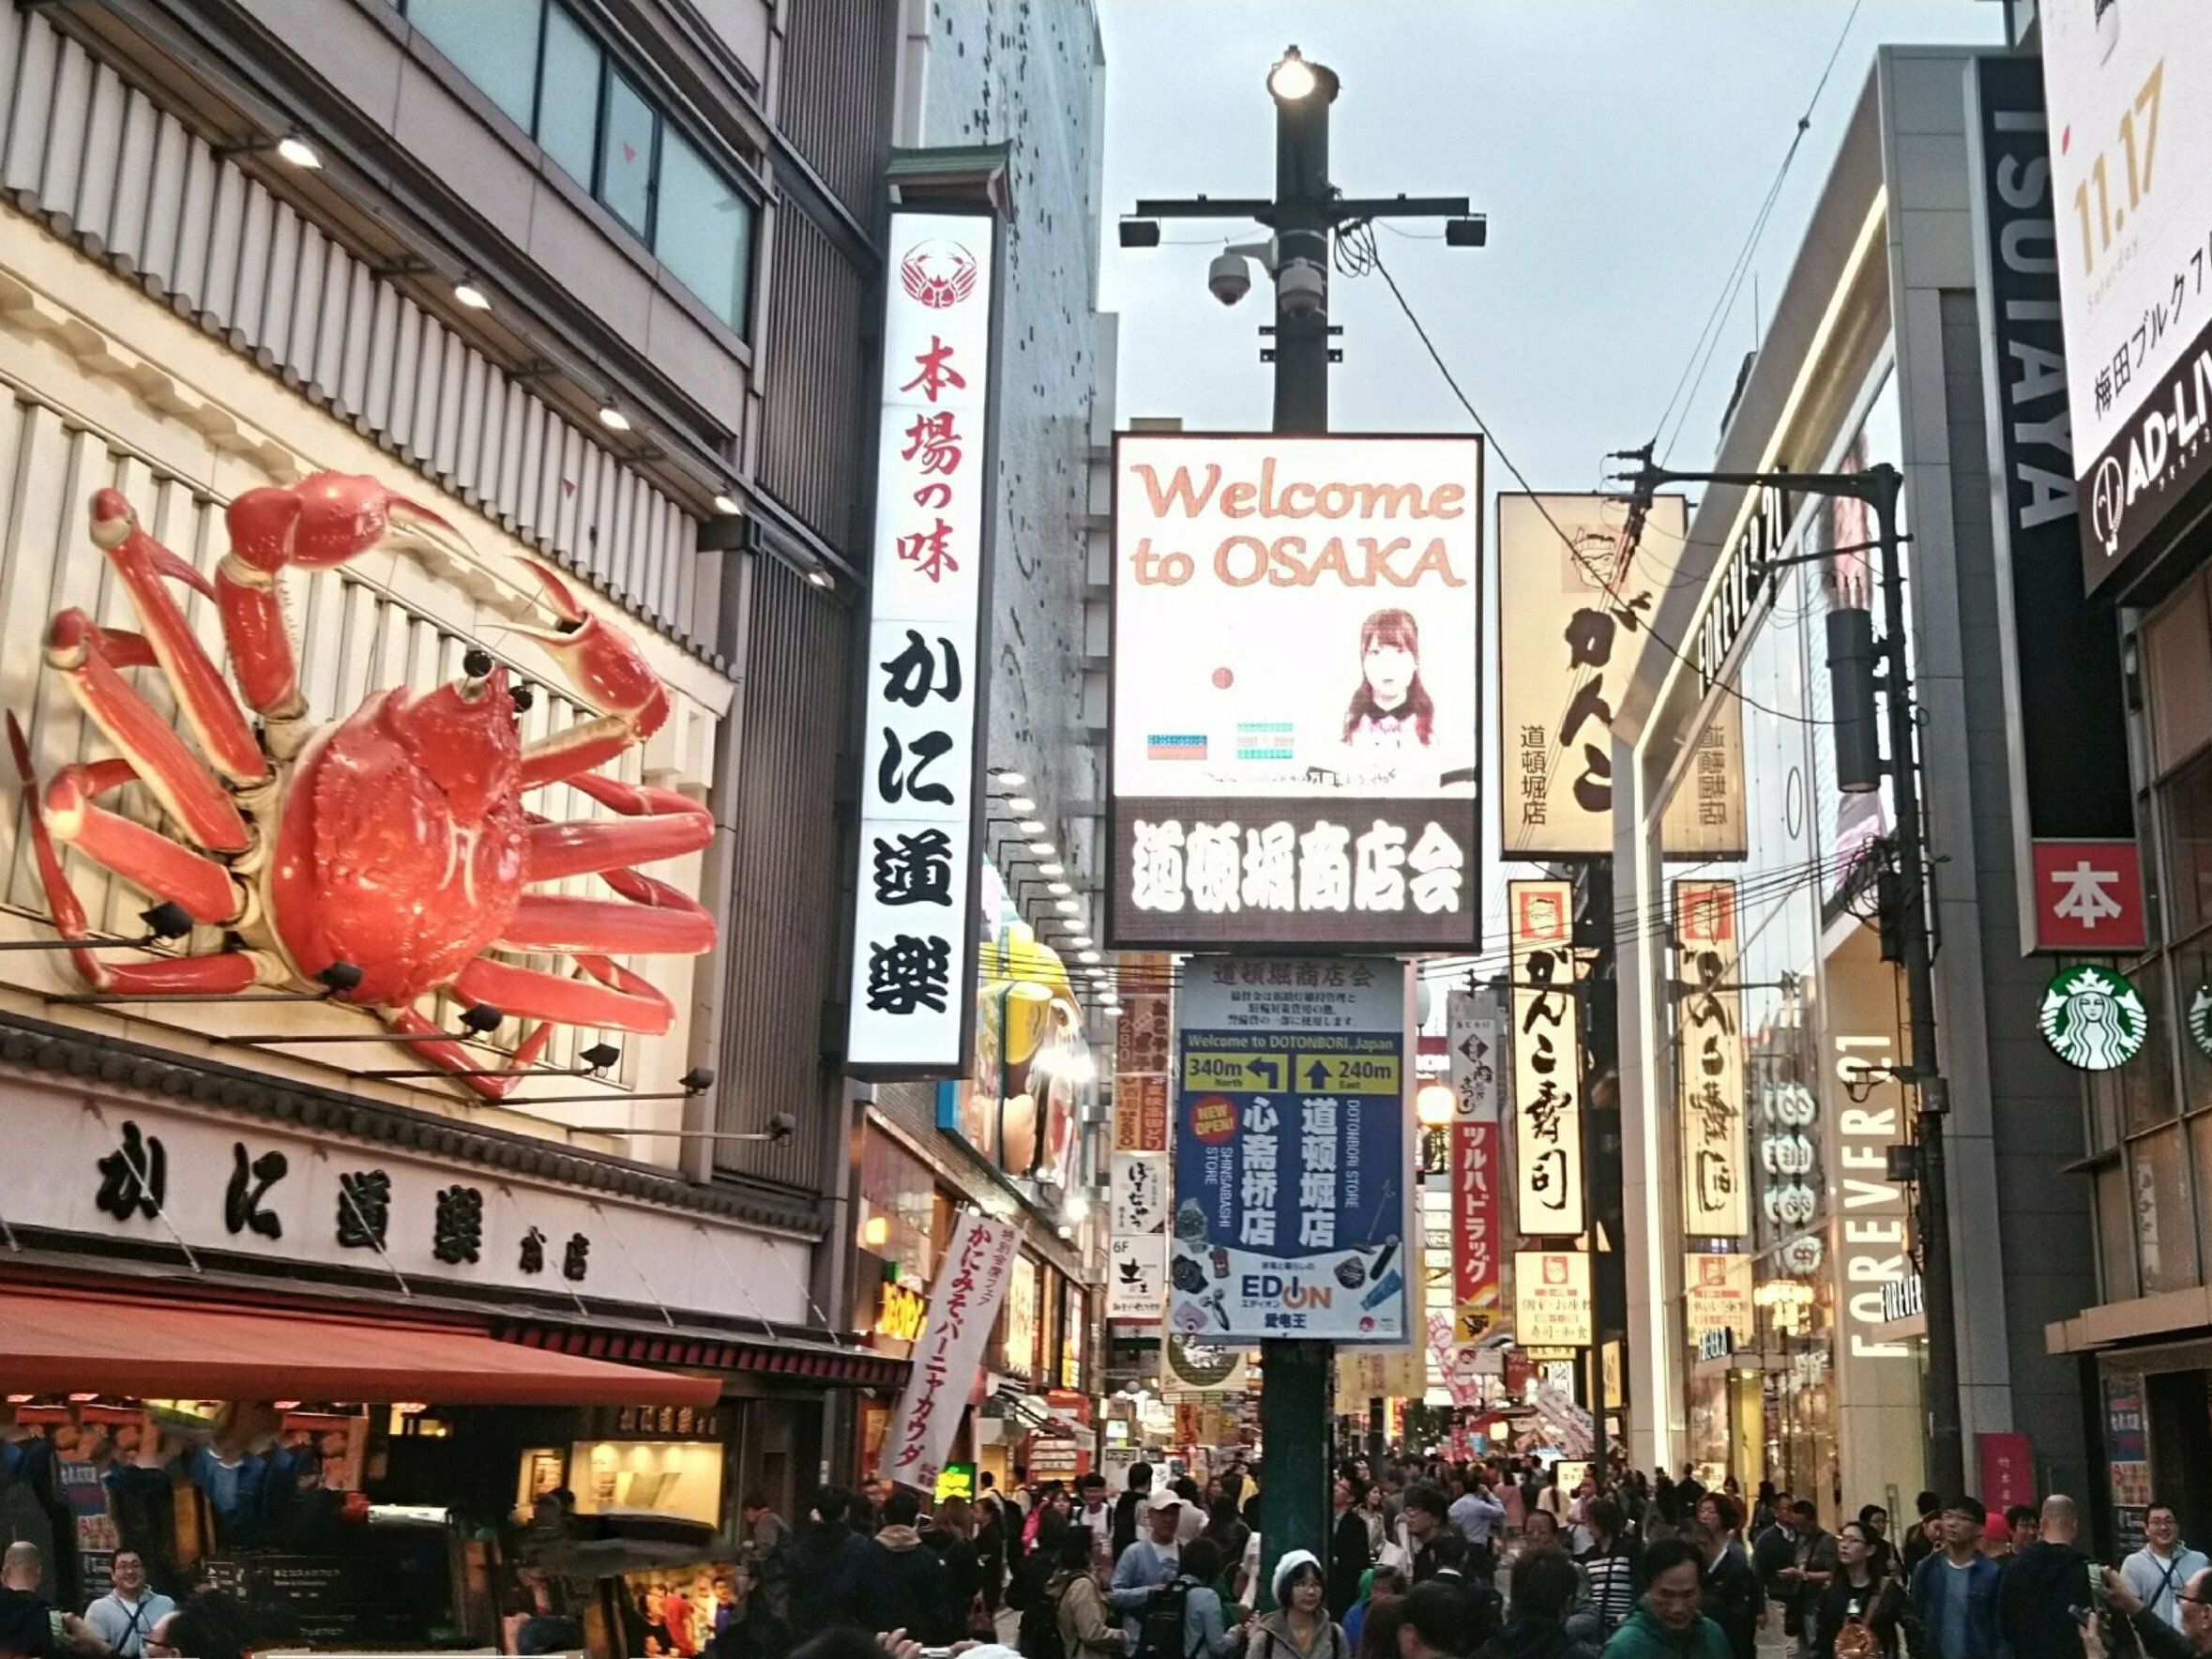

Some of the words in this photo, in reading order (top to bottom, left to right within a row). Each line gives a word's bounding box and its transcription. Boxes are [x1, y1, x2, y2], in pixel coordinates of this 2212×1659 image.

[2074, 58, 2164, 278] 11.17
[896, 334, 967, 584] 本場の味
[1129, 457, 1466, 520] Welcome
[1129, 537, 1195, 586] to
[1213, 535, 1467, 587] OSAKA
[1520, 725, 1548, 826] 道頓堀店
[865, 629, 962, 1015] かに道楽
[1131, 818, 1464, 915] 道頓堀商店会
[2051, 860, 2123, 928] 本
[1213, 960, 1376, 988] 道頓堀商店会
[1188, 1034, 1248, 1047] Welcome
[1252, 1035, 1265, 1047] to
[1355, 1038, 1394, 1051] Japan
[1189, 1058, 1242, 1077] 340m
[1215, 1078, 1243, 1088] North
[1339, 1060, 1392, 1079] 240m
[1340, 1080, 1361, 1089] East
[1197, 1103, 1229, 1119] NEW
[1344, 1100, 1360, 1169] DOTONBORI
[1204, 1146, 1219, 1186] STORE
[1220, 1146, 1234, 1228] SHINSAIBASHI
[1344, 1170, 1360, 1209] STORE
[1461, 1126, 1492, 1284] ツルハドラッグ
[1113, 1240, 1129, 1254] 6F
[1840, 1107, 1909, 1358] FOREVER
[1241, 1274, 1332, 1309] EDION
[1880, 1273, 1923, 1323] FOREVER
[892, 1223, 992, 1469] かにみそバーニャカウダ
